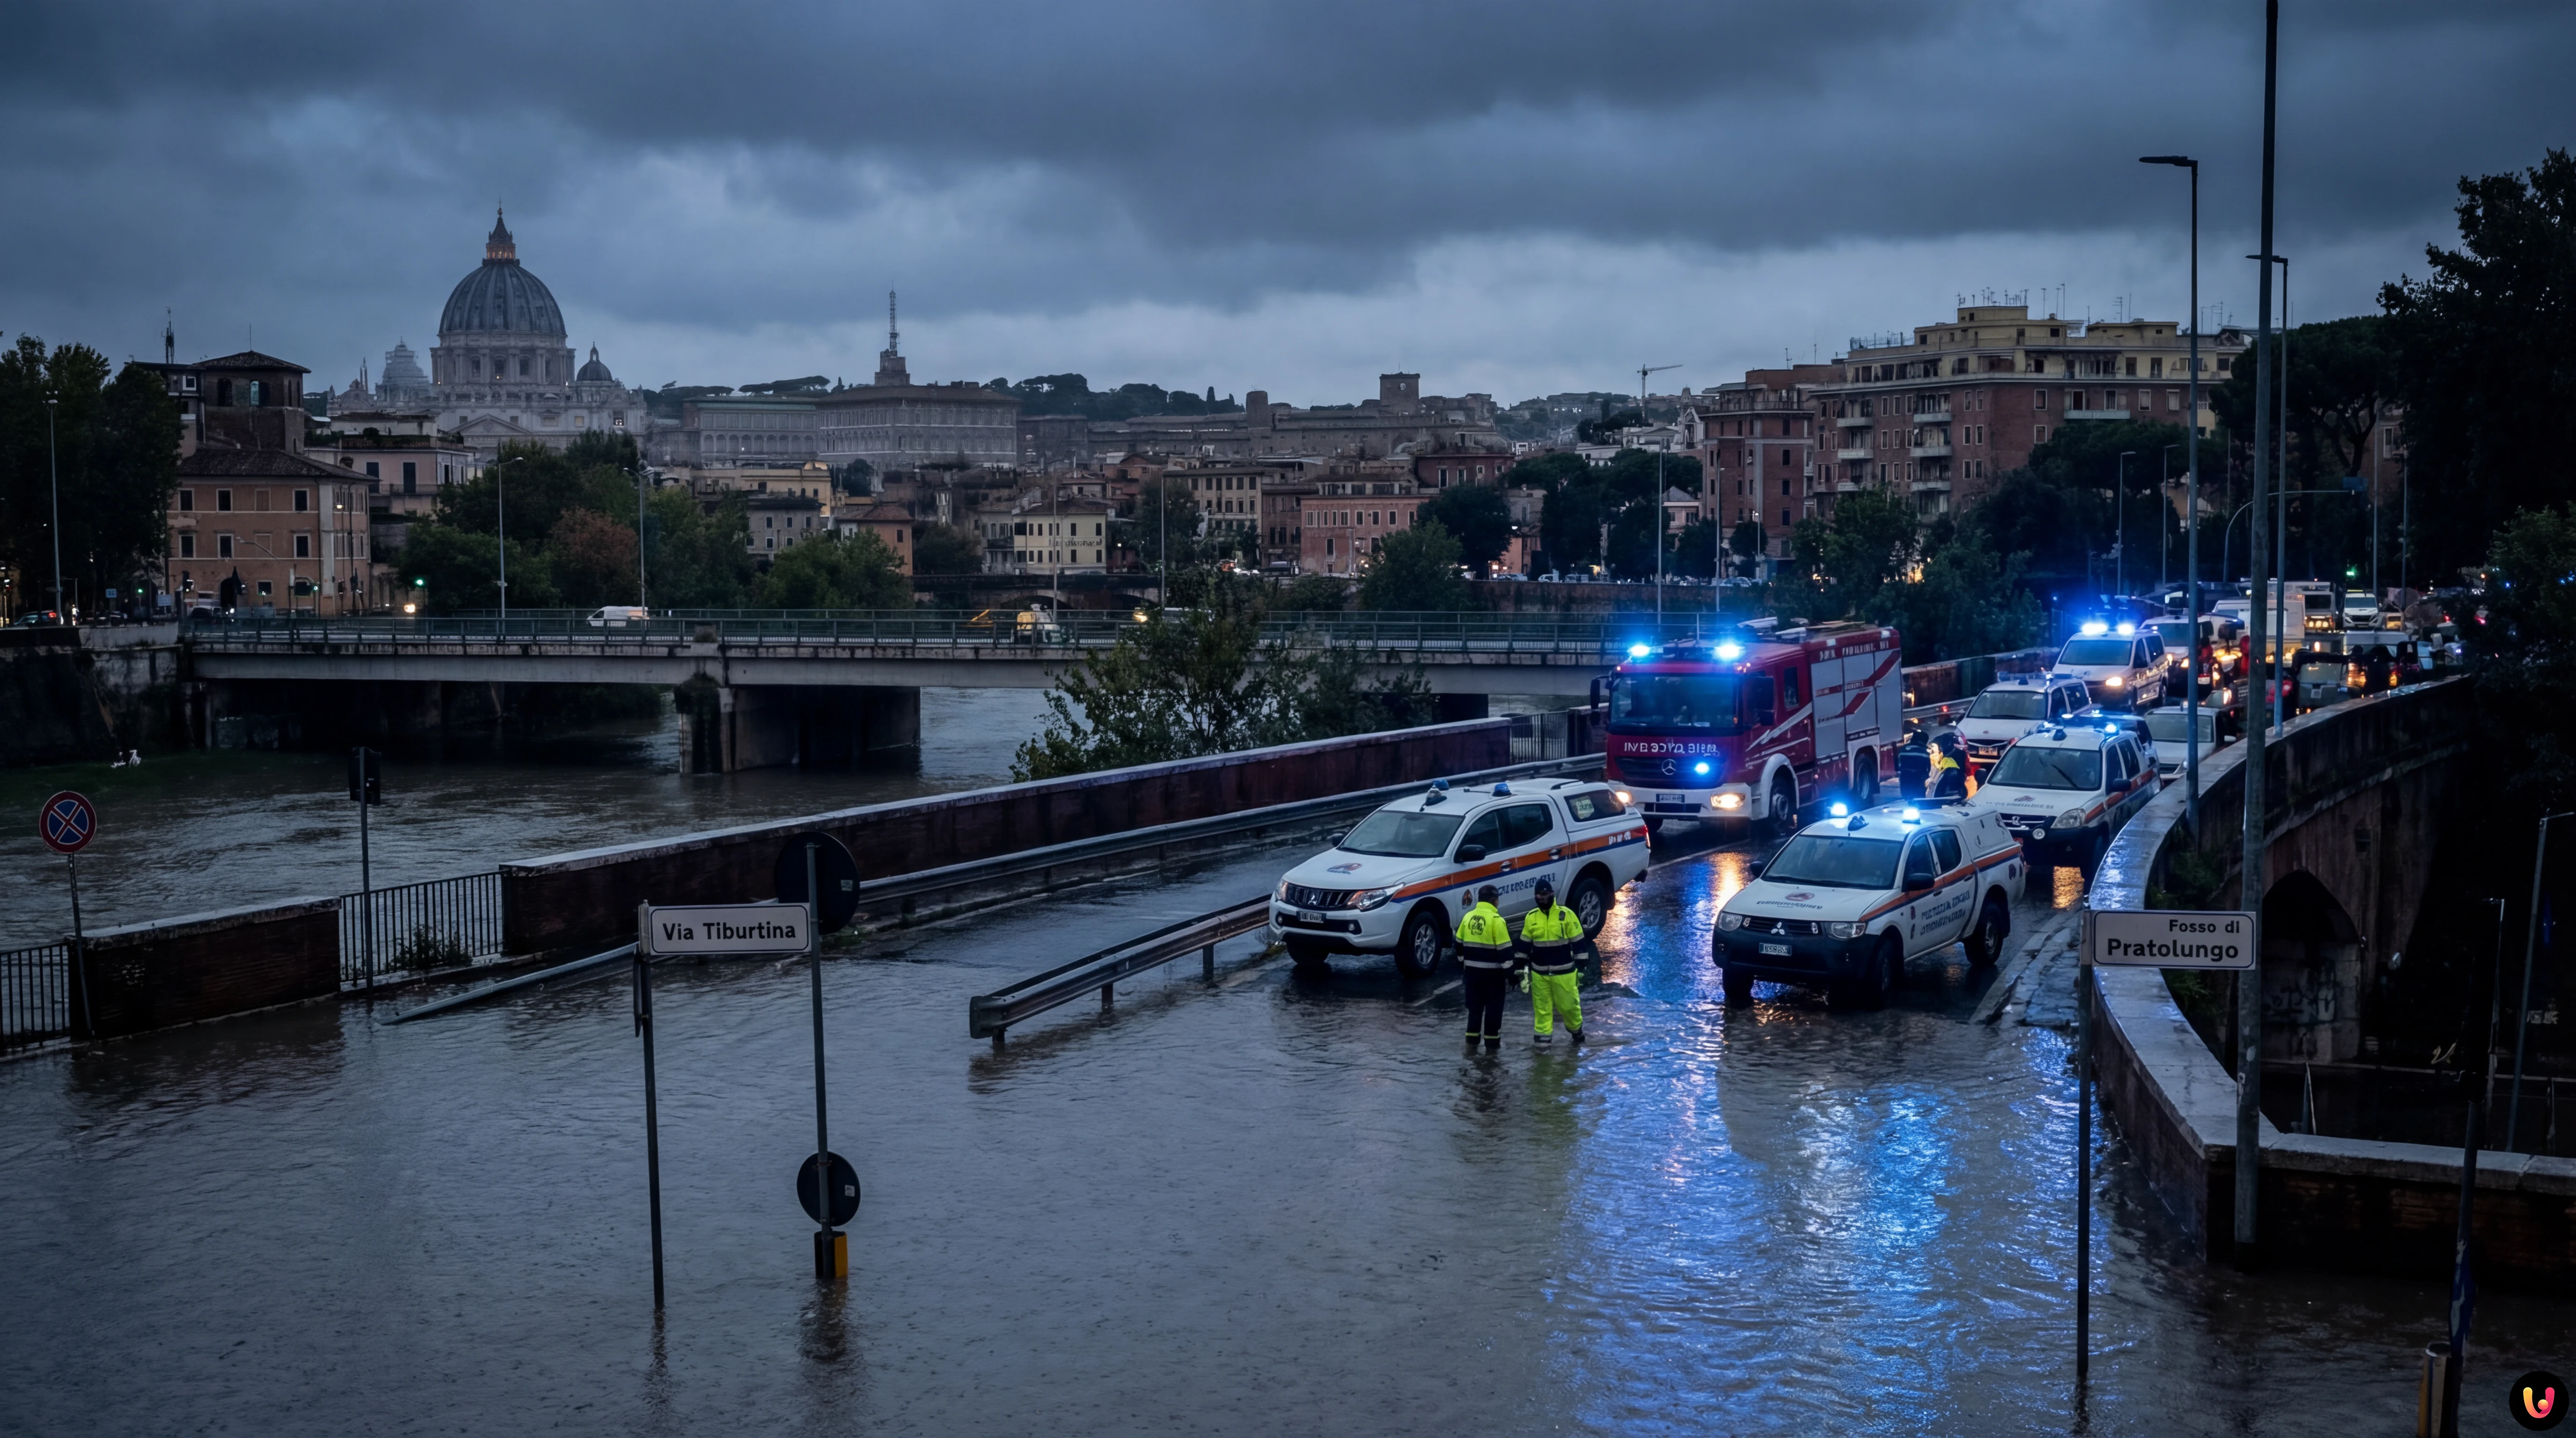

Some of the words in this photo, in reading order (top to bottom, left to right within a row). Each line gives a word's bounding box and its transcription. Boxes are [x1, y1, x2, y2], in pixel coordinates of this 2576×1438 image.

[662, 923, 694, 940] Via
[703, 921, 796, 940] Tiburtina
[2169, 919, 2217, 933] Fosso
[2225, 920, 2240, 933] di
[2108, 938, 2239, 962] Pratolungo
